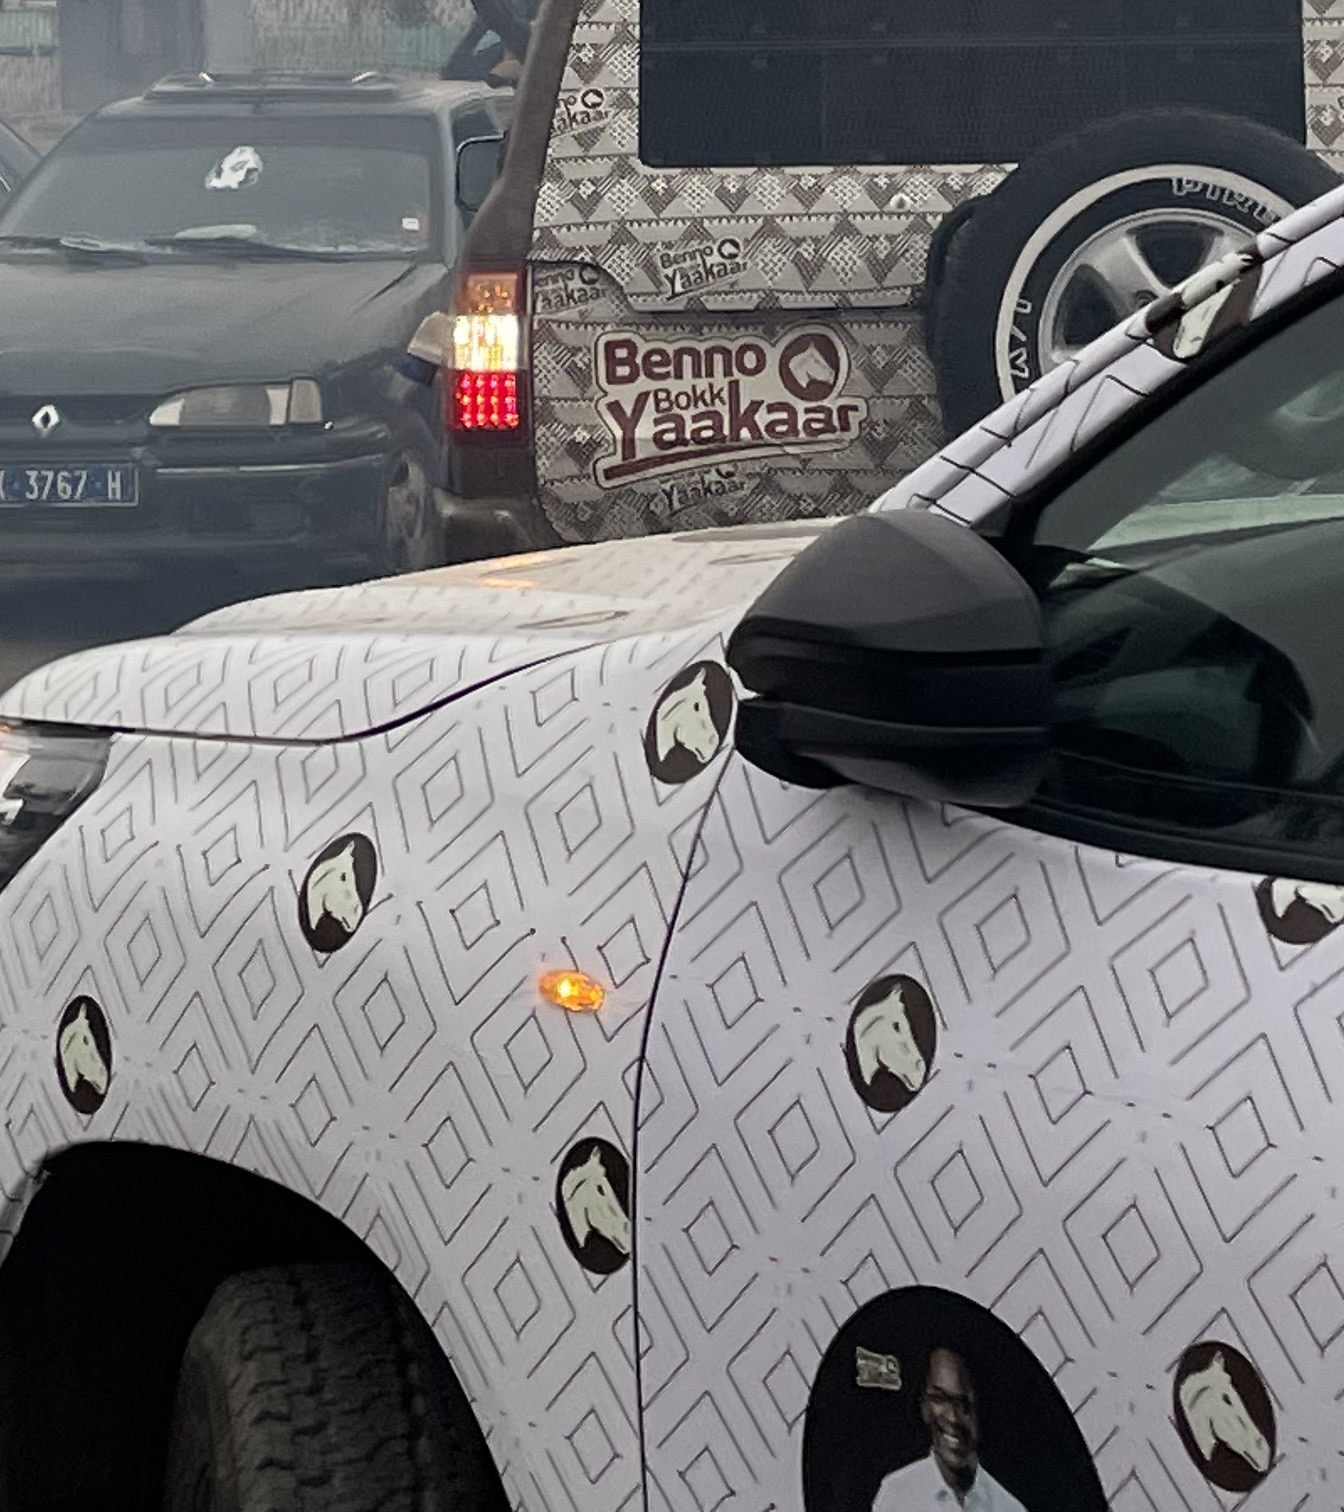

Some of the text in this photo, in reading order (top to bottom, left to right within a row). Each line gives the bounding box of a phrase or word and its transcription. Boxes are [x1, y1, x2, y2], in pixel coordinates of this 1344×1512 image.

[660, 245, 714, 269] Benno
[664, 250, 748, 296] Yaakaar
[605, 338, 766, 385] Benno
[655, 382, 726, 414] Bokk
[605, 379, 859, 462] Yaakaar
[25, 469, 88, 501] 3767
[108, 469, 121, 500] H
